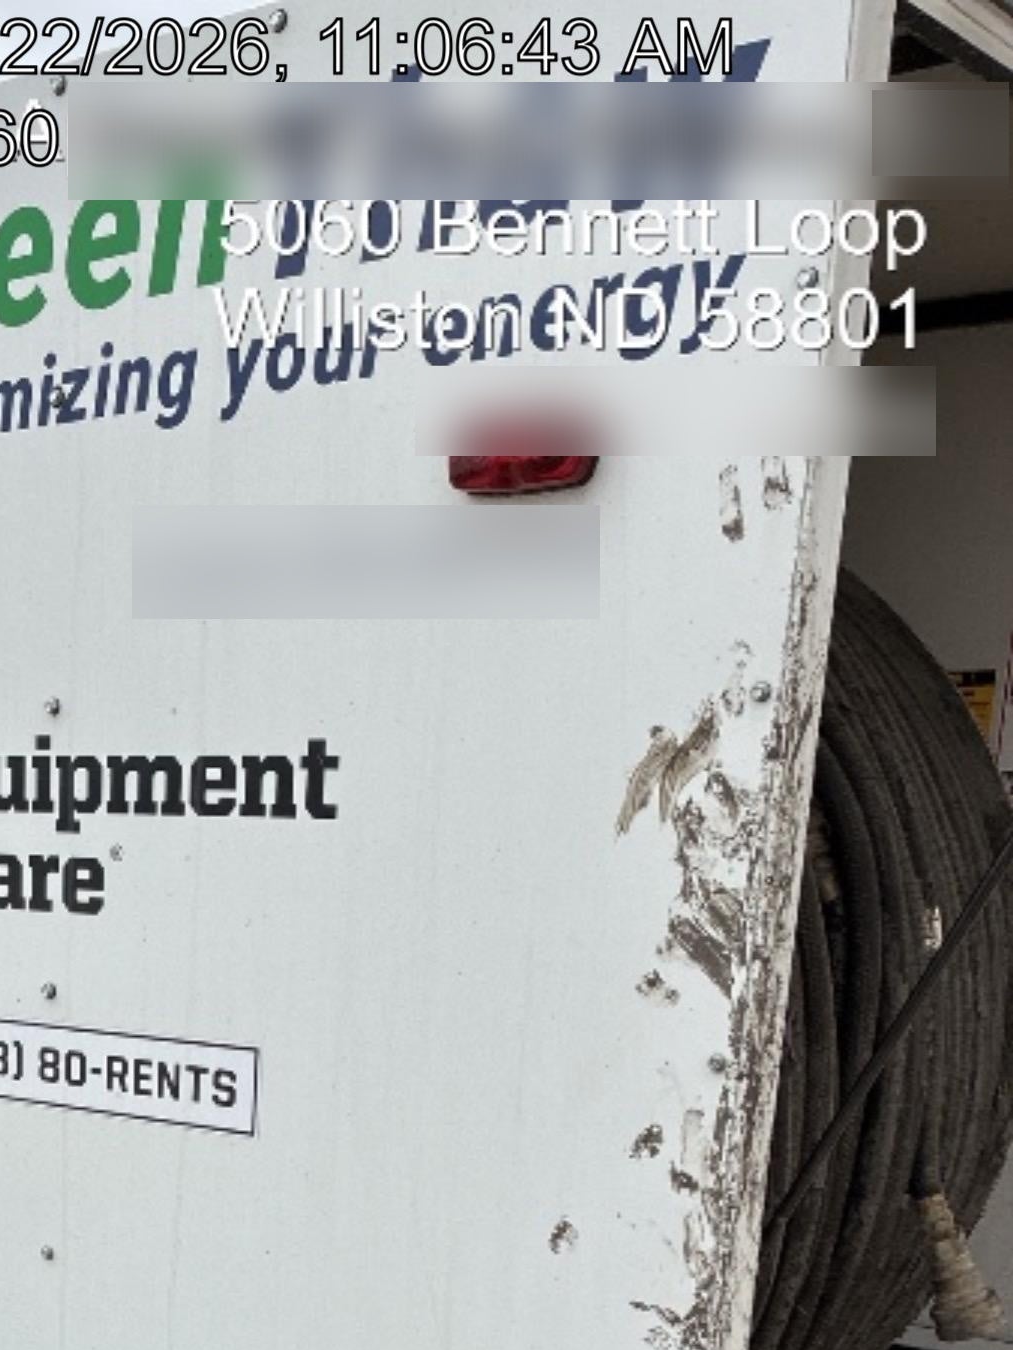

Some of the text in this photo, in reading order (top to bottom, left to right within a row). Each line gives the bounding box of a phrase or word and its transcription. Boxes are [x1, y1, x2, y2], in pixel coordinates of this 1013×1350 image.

[221, 318, 390, 421] your
[424, 255, 746, 367] energy
[38, 1046, 239, 1108] 80-RENTS
